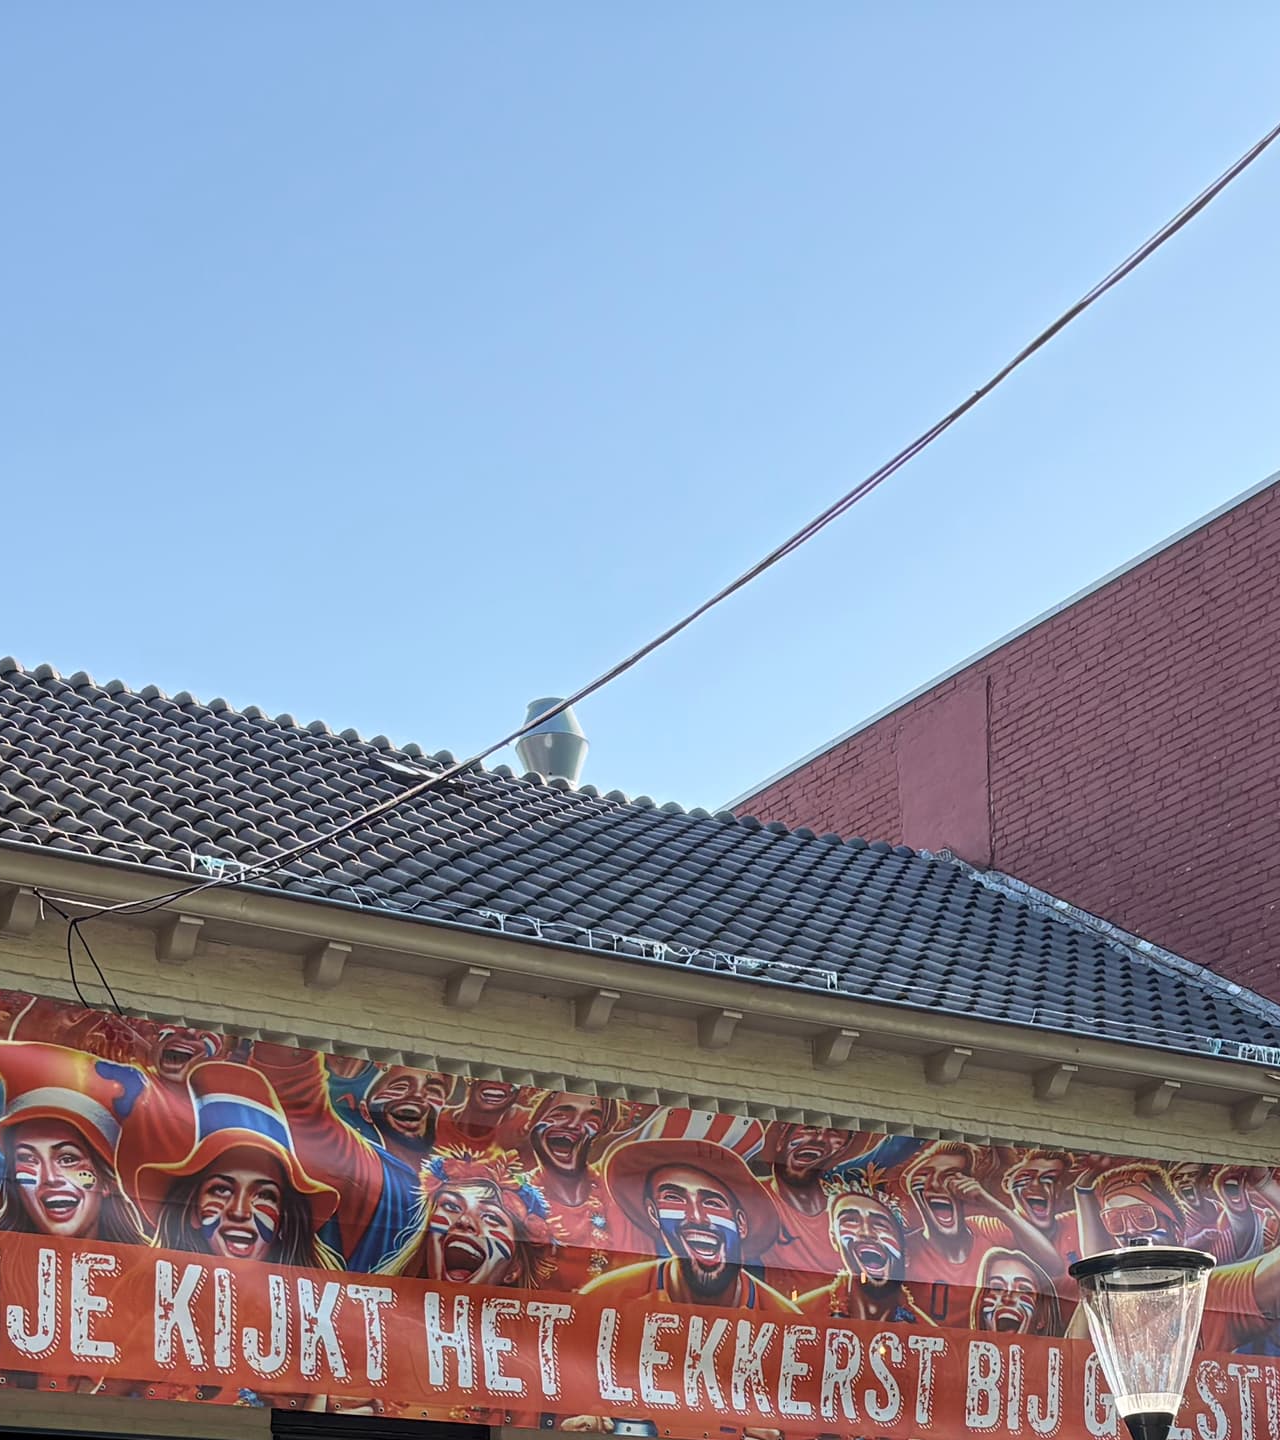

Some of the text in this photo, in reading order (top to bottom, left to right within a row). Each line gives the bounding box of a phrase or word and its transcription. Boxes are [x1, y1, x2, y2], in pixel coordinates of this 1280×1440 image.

[152, 1260, 394, 1384] KIJKT
[423, 1292, 573, 1398] HET
[595, 1307, 946, 1424] LEKKERST
[964, 1340, 1062, 1435] BIJ
